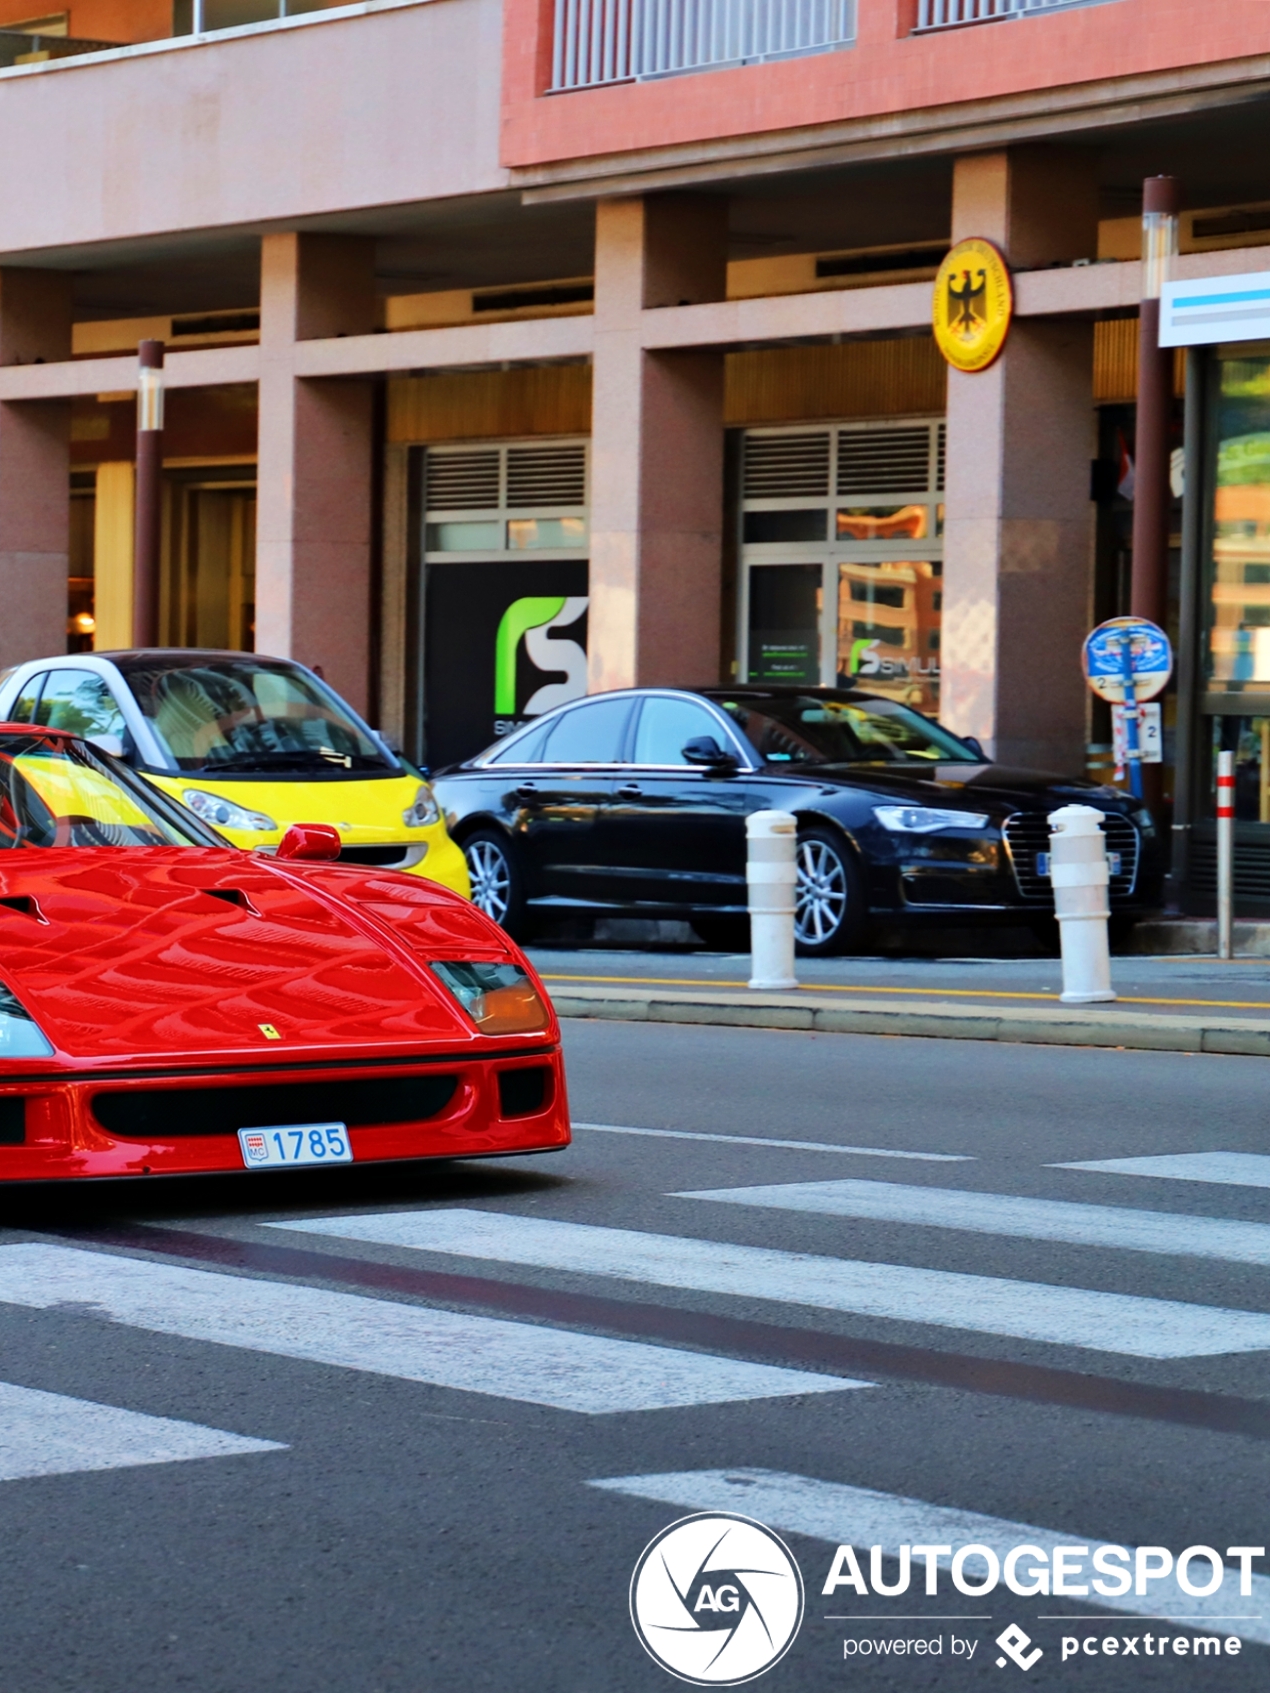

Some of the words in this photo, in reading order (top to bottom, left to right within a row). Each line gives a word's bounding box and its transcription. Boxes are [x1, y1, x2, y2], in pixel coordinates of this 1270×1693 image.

[1097, 677, 1107, 689] 2
[1148, 726, 1157, 738] 2
[250, 1147, 265, 1157] MC
[273, 1128, 345, 1160] 1785
